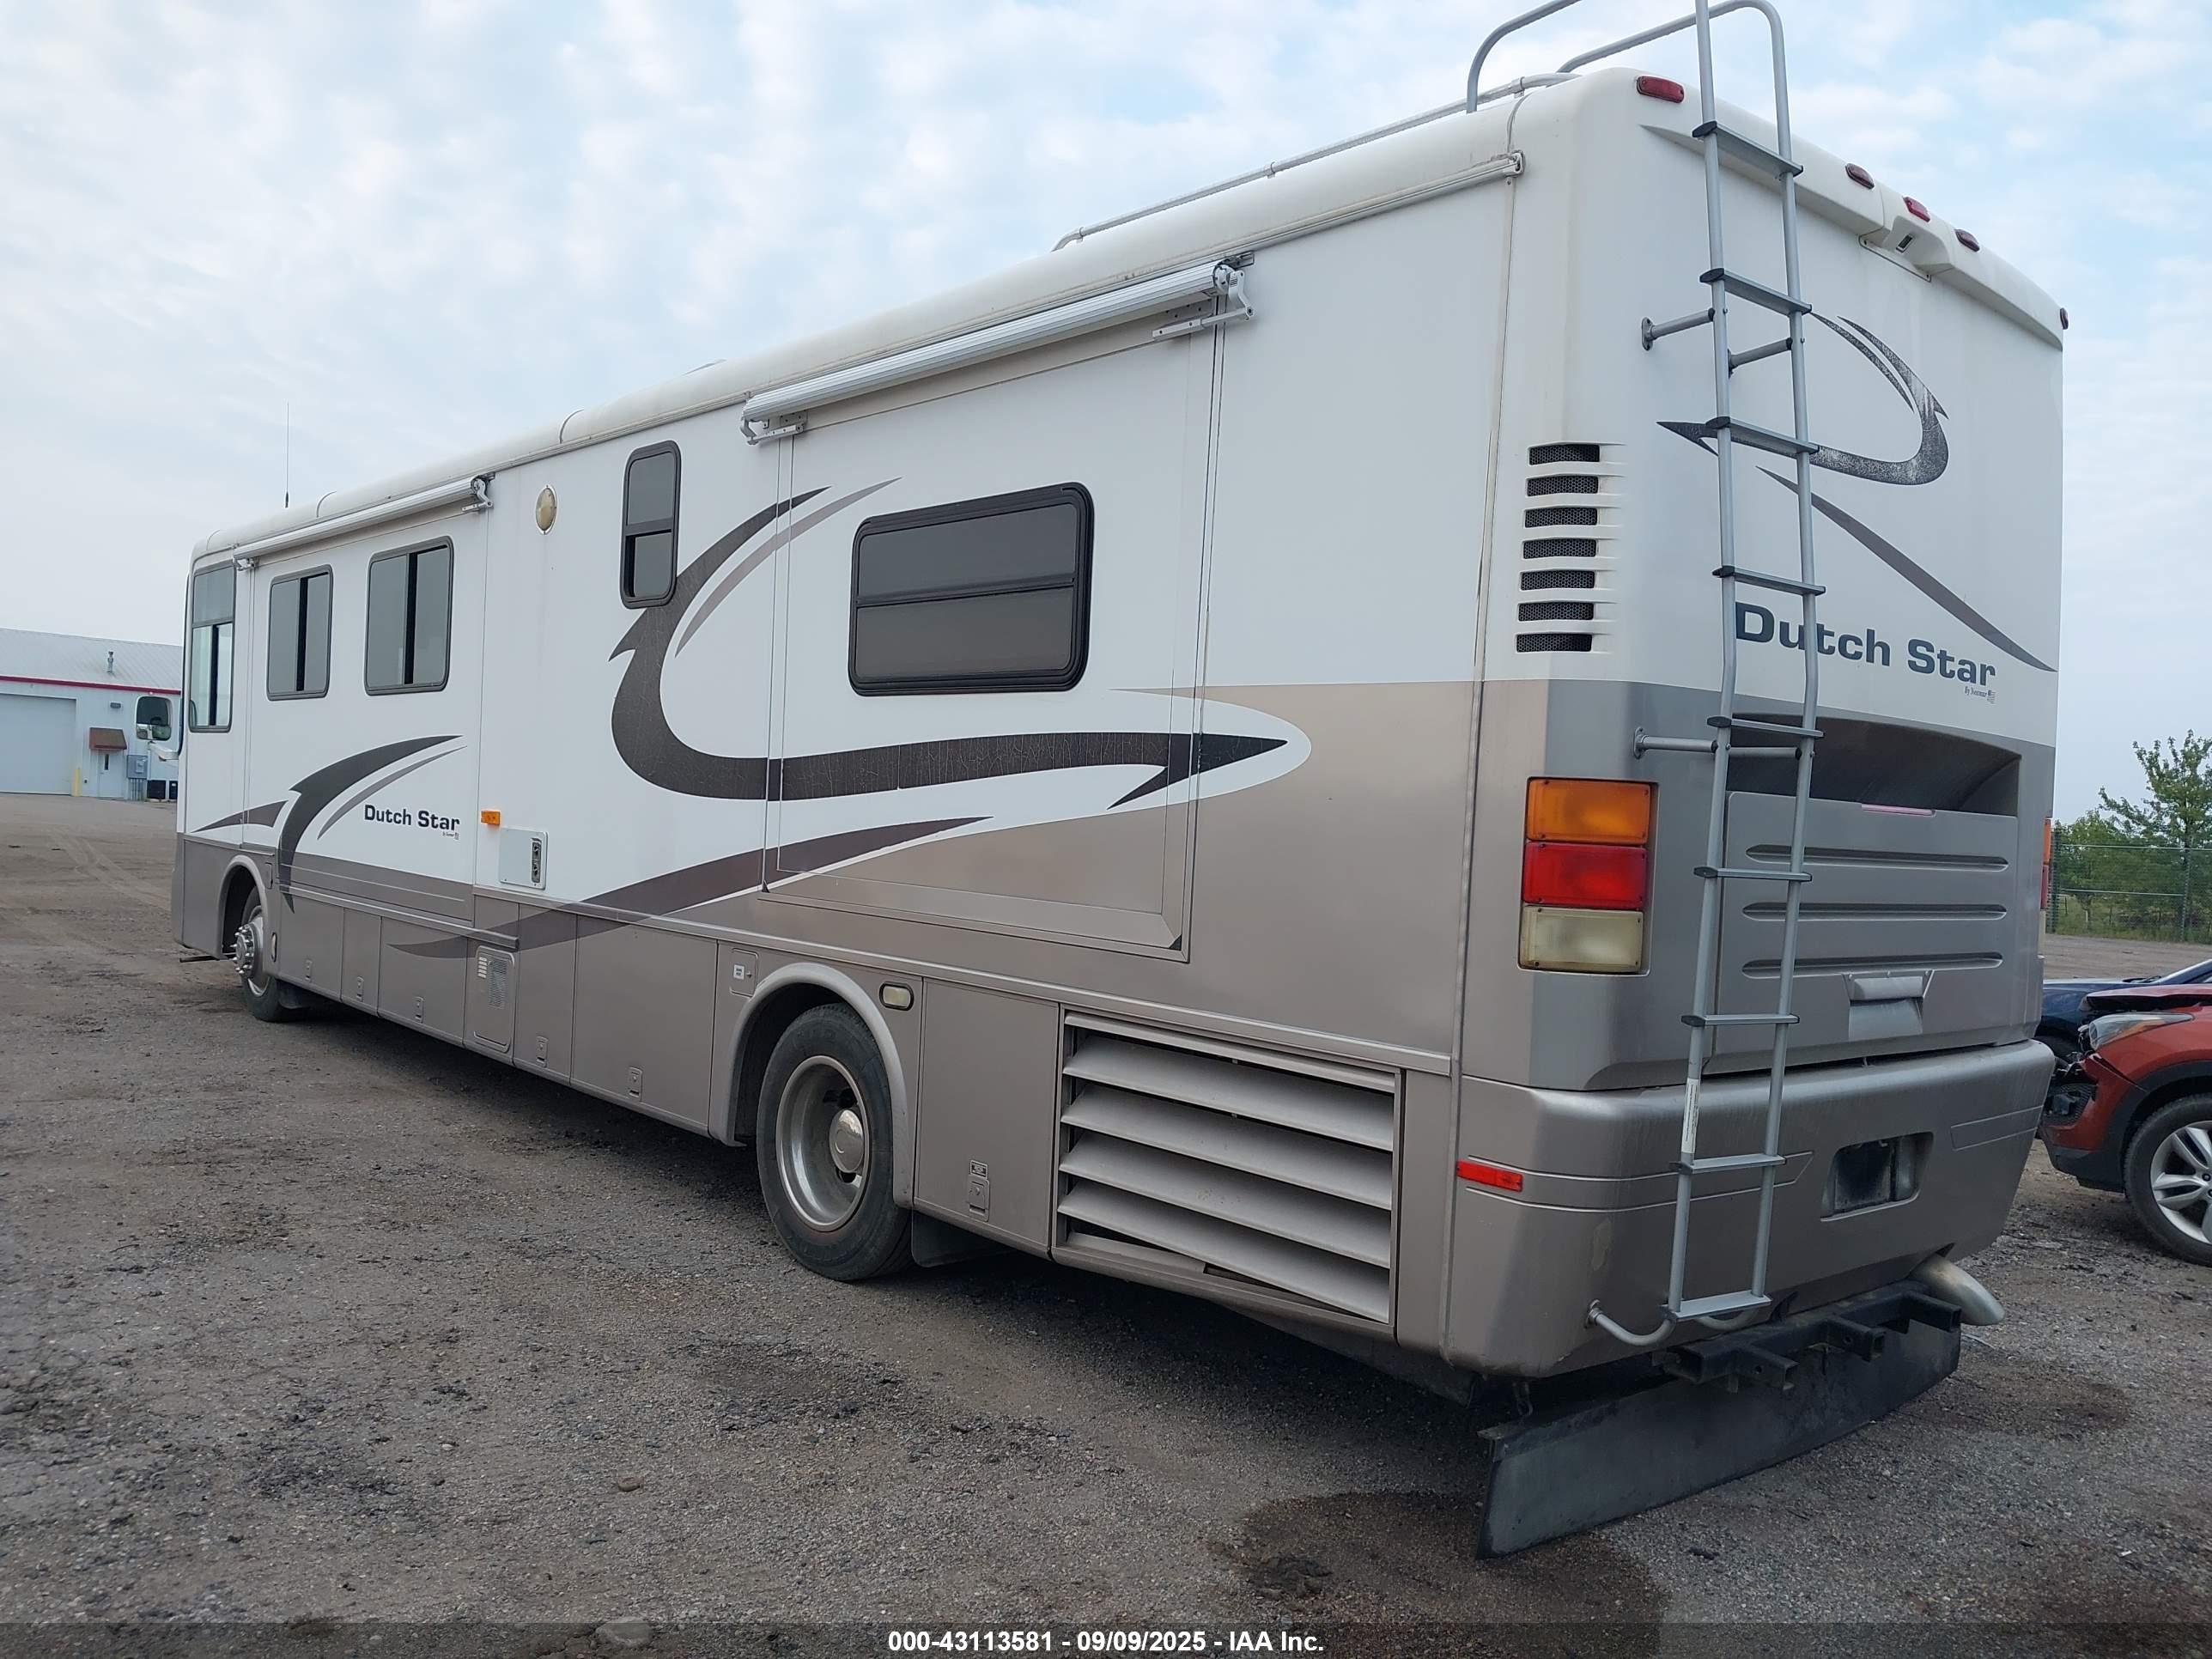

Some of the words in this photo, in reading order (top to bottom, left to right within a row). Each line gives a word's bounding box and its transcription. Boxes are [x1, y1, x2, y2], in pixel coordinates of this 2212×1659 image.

[1735, 601, 1890, 667] Dutch
[1907, 638, 1996, 685] Star
[364, 804, 411, 825] Dutch
[417, 810, 460, 830] Star
